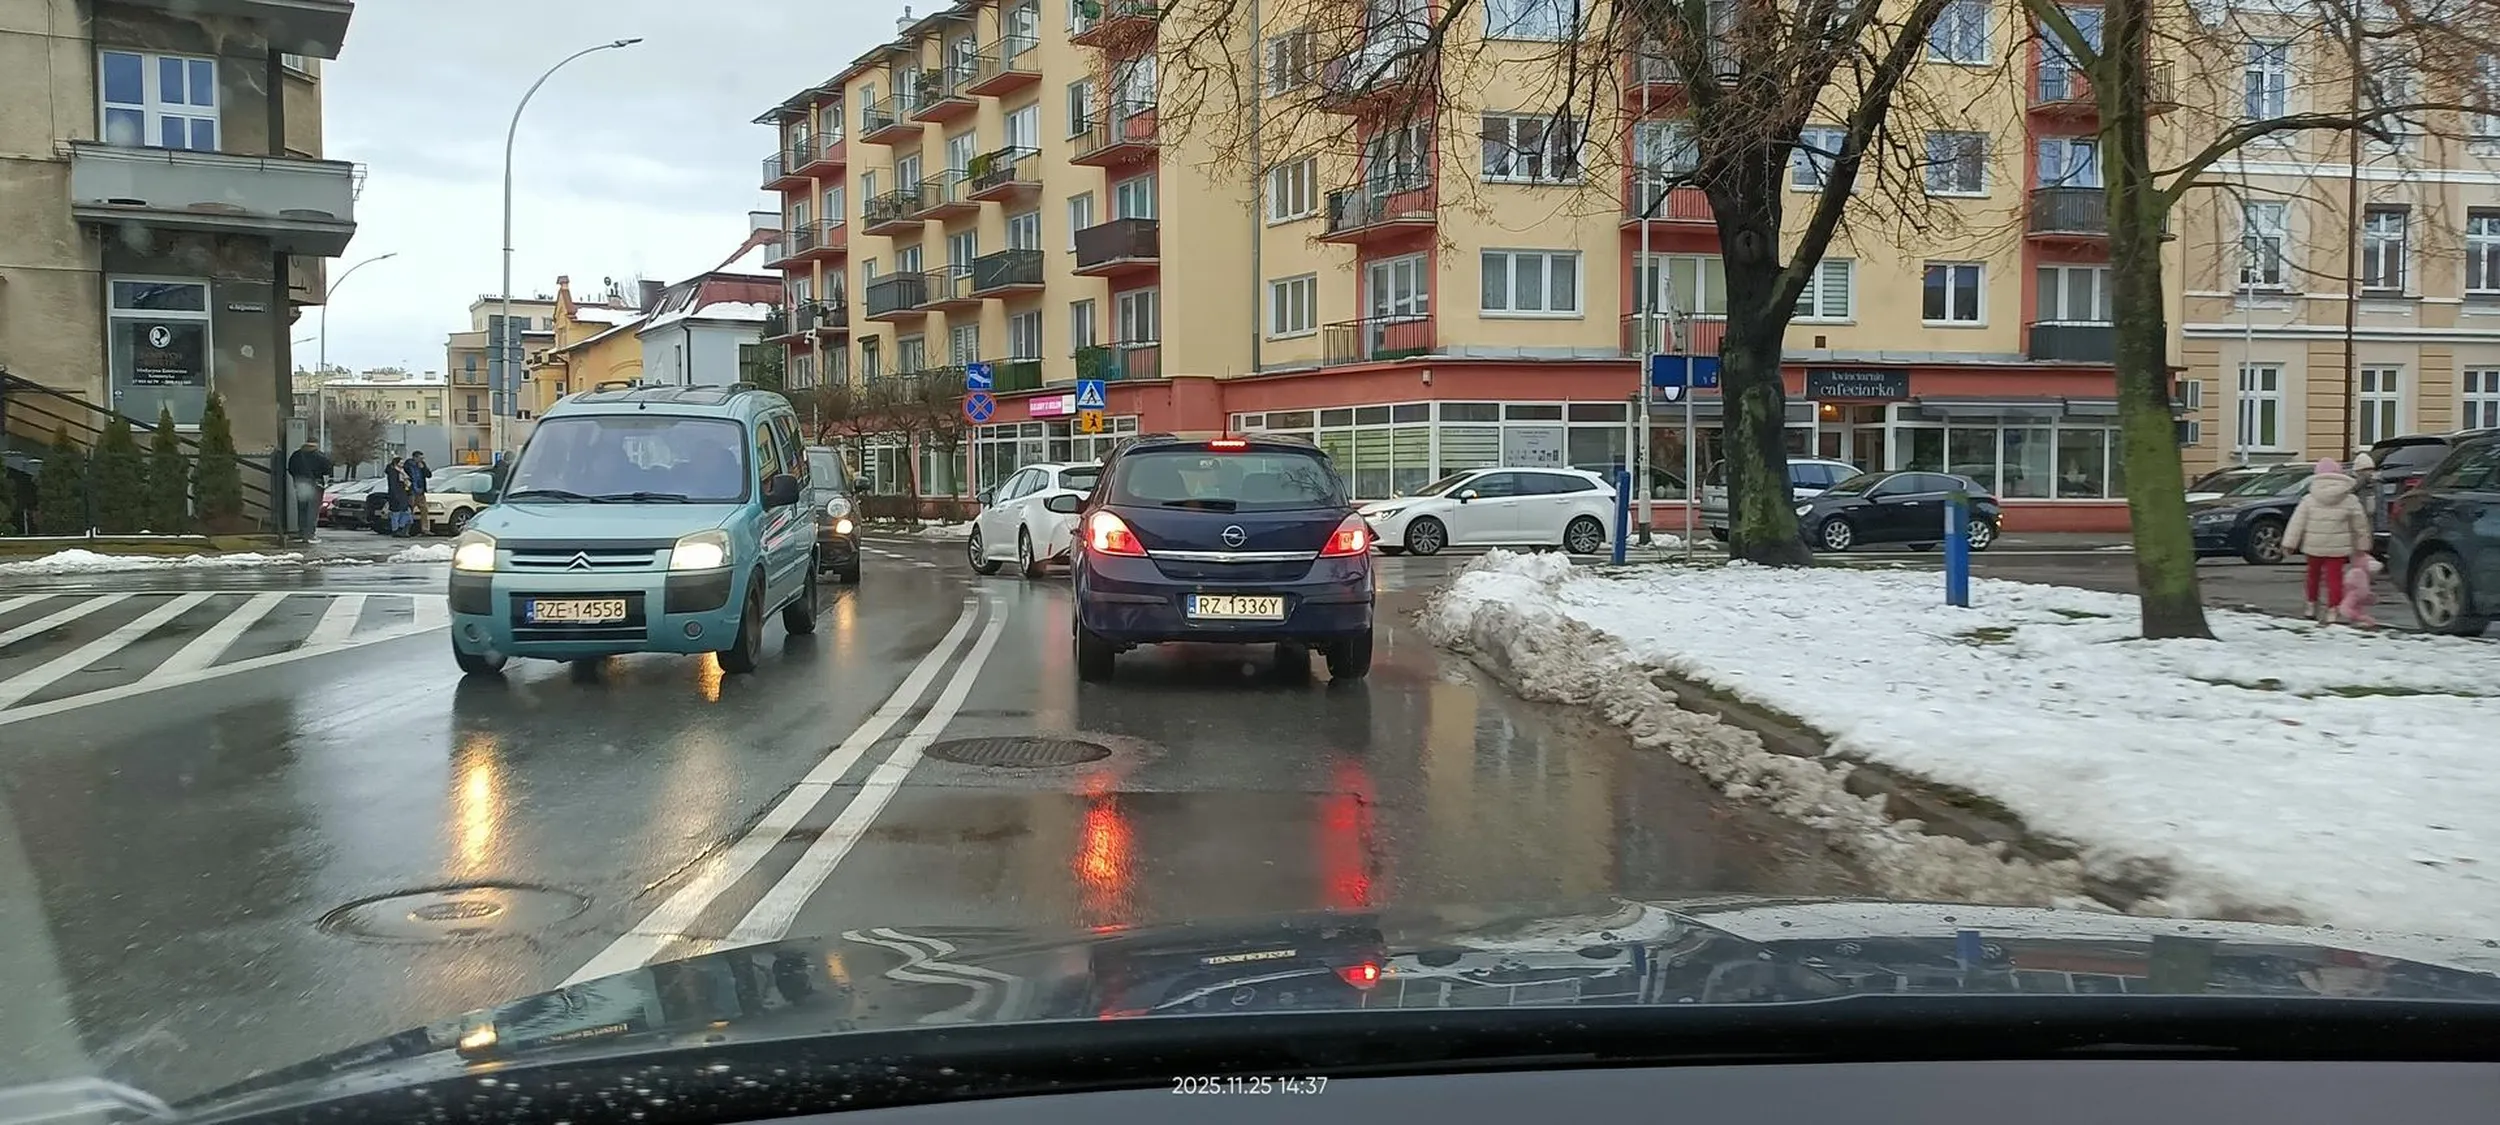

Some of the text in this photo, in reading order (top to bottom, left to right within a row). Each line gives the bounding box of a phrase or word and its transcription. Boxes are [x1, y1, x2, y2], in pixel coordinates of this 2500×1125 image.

[1820, 383, 1895, 396] cafeciarka
[535, 602, 623, 618] RZE 14558
[1200, 597, 1277, 614] RZ 1336Y
